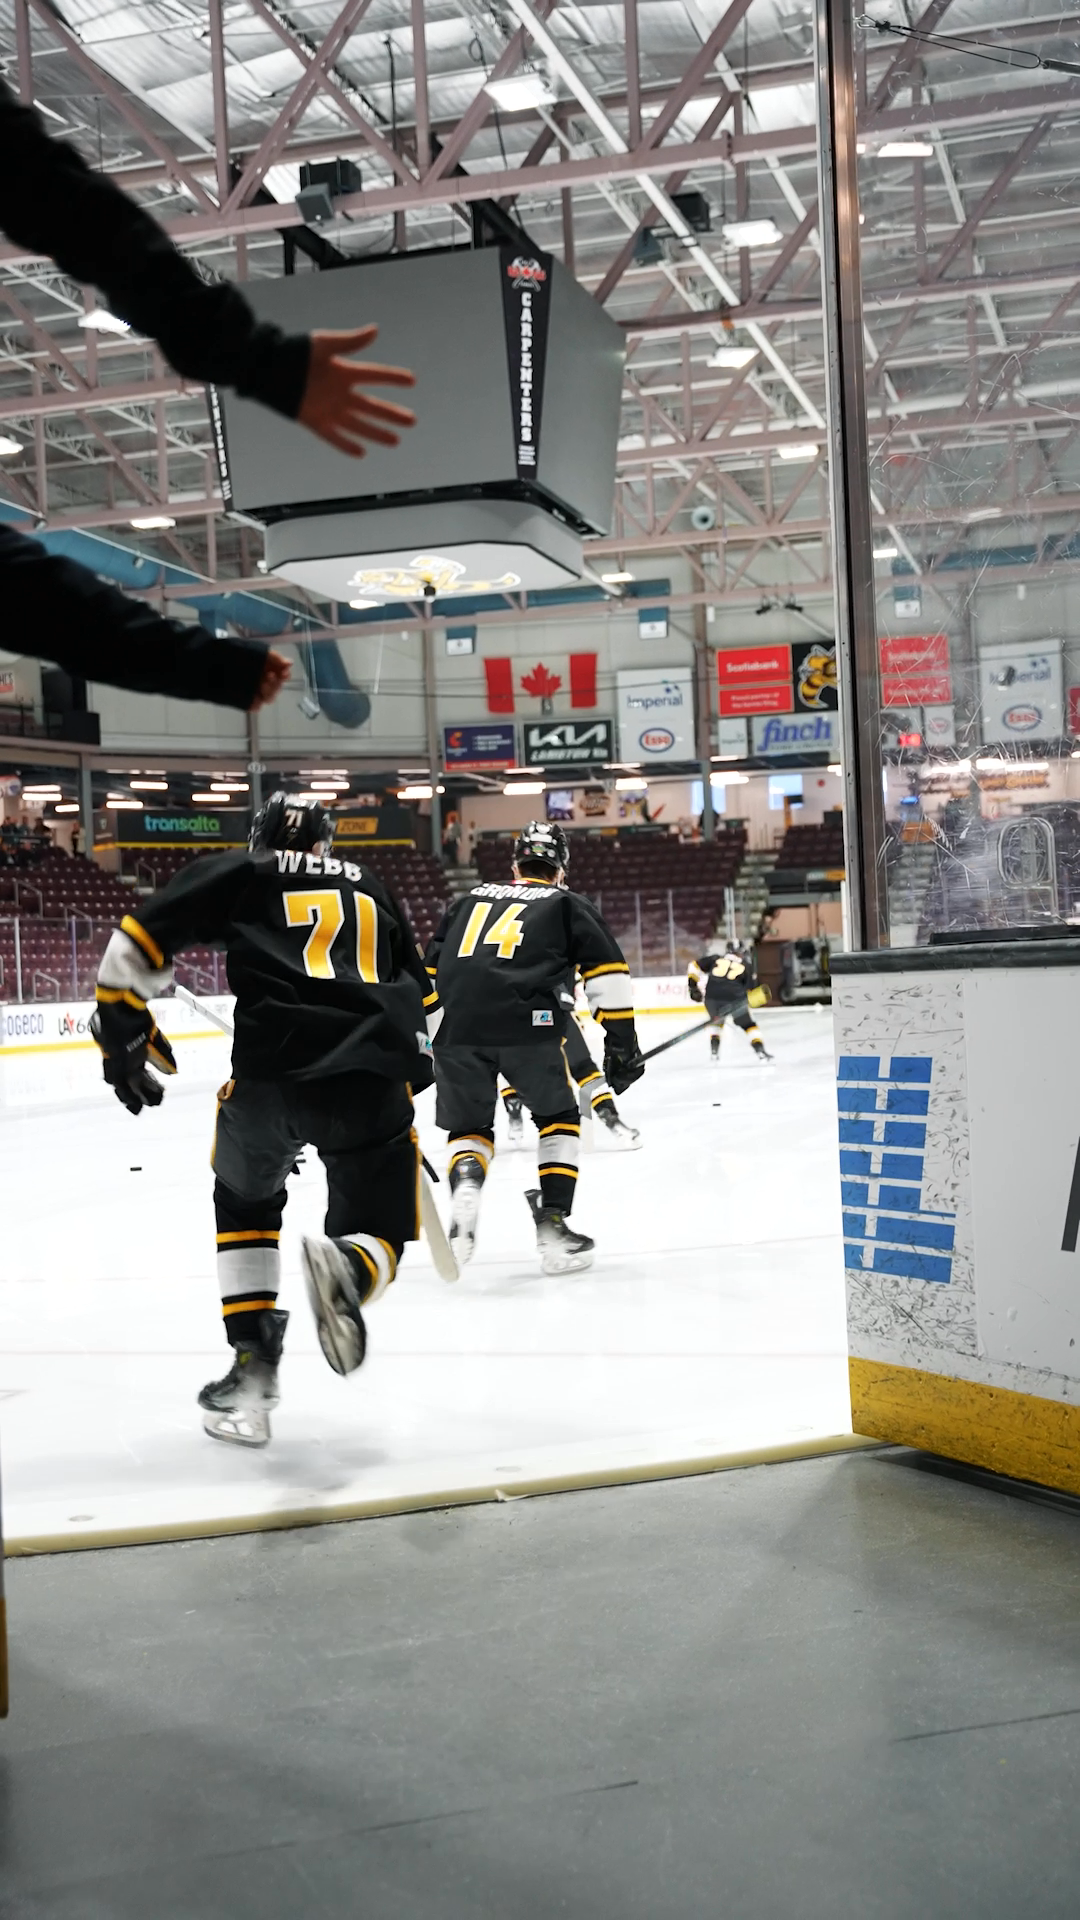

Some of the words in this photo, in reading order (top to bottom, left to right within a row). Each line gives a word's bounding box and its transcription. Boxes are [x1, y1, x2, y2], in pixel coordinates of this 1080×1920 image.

[520, 292, 533, 442] CARPENTERS
[726, 660, 779, 673] Scotiabank
[627, 693, 684, 711] Imperial
[644, 734, 671, 747] Esso
[757, 716, 833, 752] finch
[143, 814, 220, 832] transalta
[285, 808, 304, 828] 71
[275, 850, 363, 882] WEBB
[282, 889, 380, 984] 71
[457, 901, 528, 960] 14
